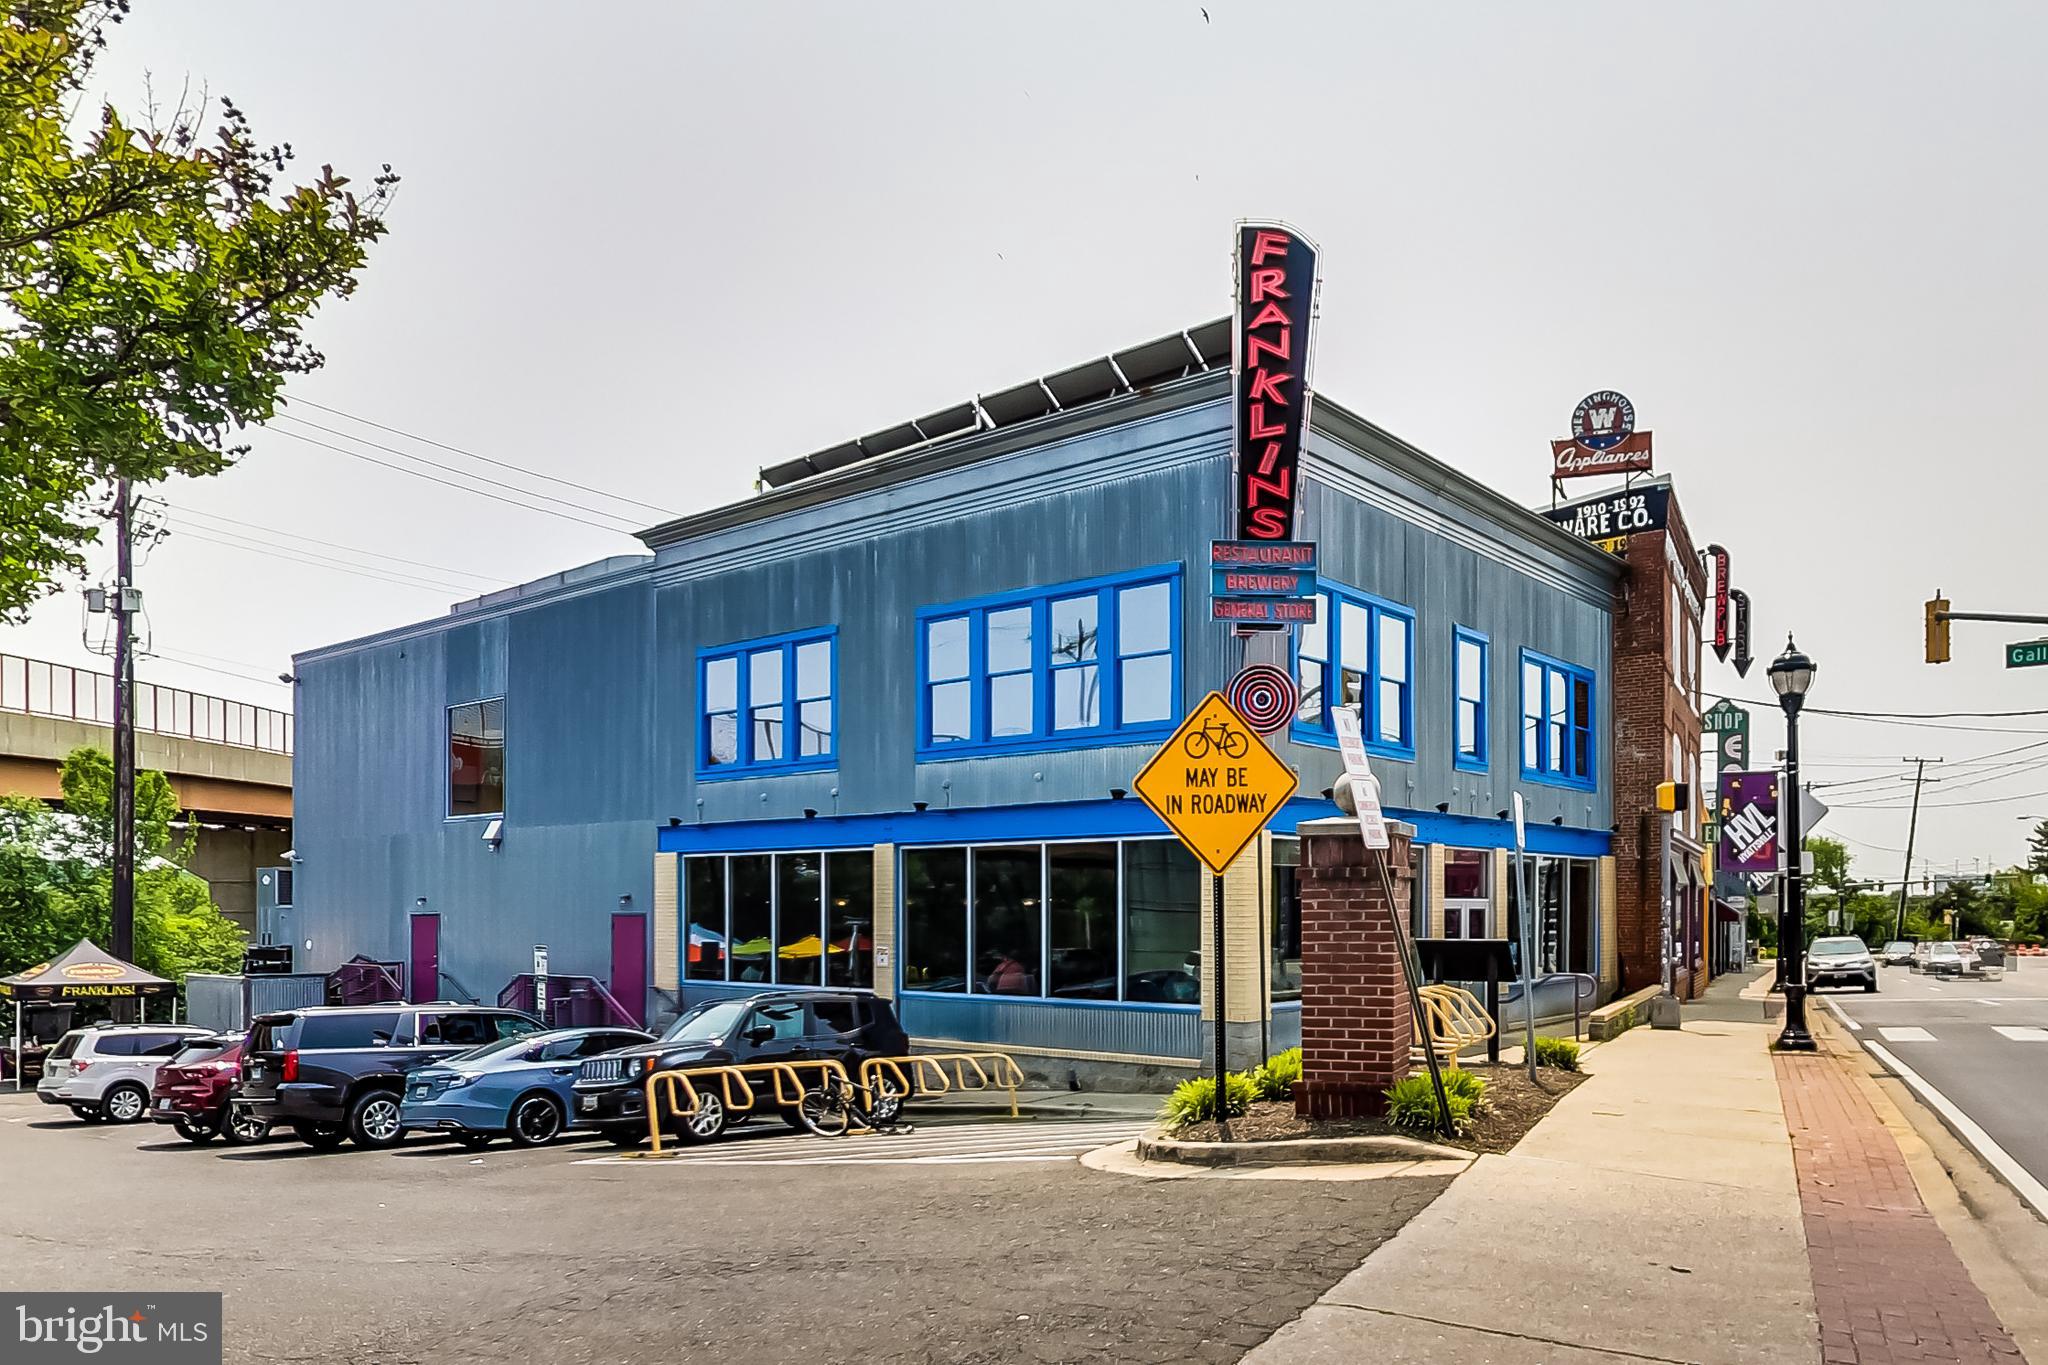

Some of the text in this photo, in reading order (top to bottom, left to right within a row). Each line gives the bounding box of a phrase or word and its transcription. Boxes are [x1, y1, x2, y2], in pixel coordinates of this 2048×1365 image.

[1246, 230, 1292, 539] FRANKLINS
[1557, 447, 1649, 472] Appliances
[1618, 507, 1654, 530] CO.
[1213, 545, 1313, 563] RESTAURANT
[1226, 572, 1298, 590] BREWERY
[1214, 601, 1313, 620] GENERAL STORE
[1704, 712, 1744, 730] SHOP
[1186, 767, 1248, 788] MAY BE
[1166, 793, 1268, 815] IN ROADWAY
[1723, 802, 1776, 850] HVL
[61, 985, 136, 997] FRANKLINS!
